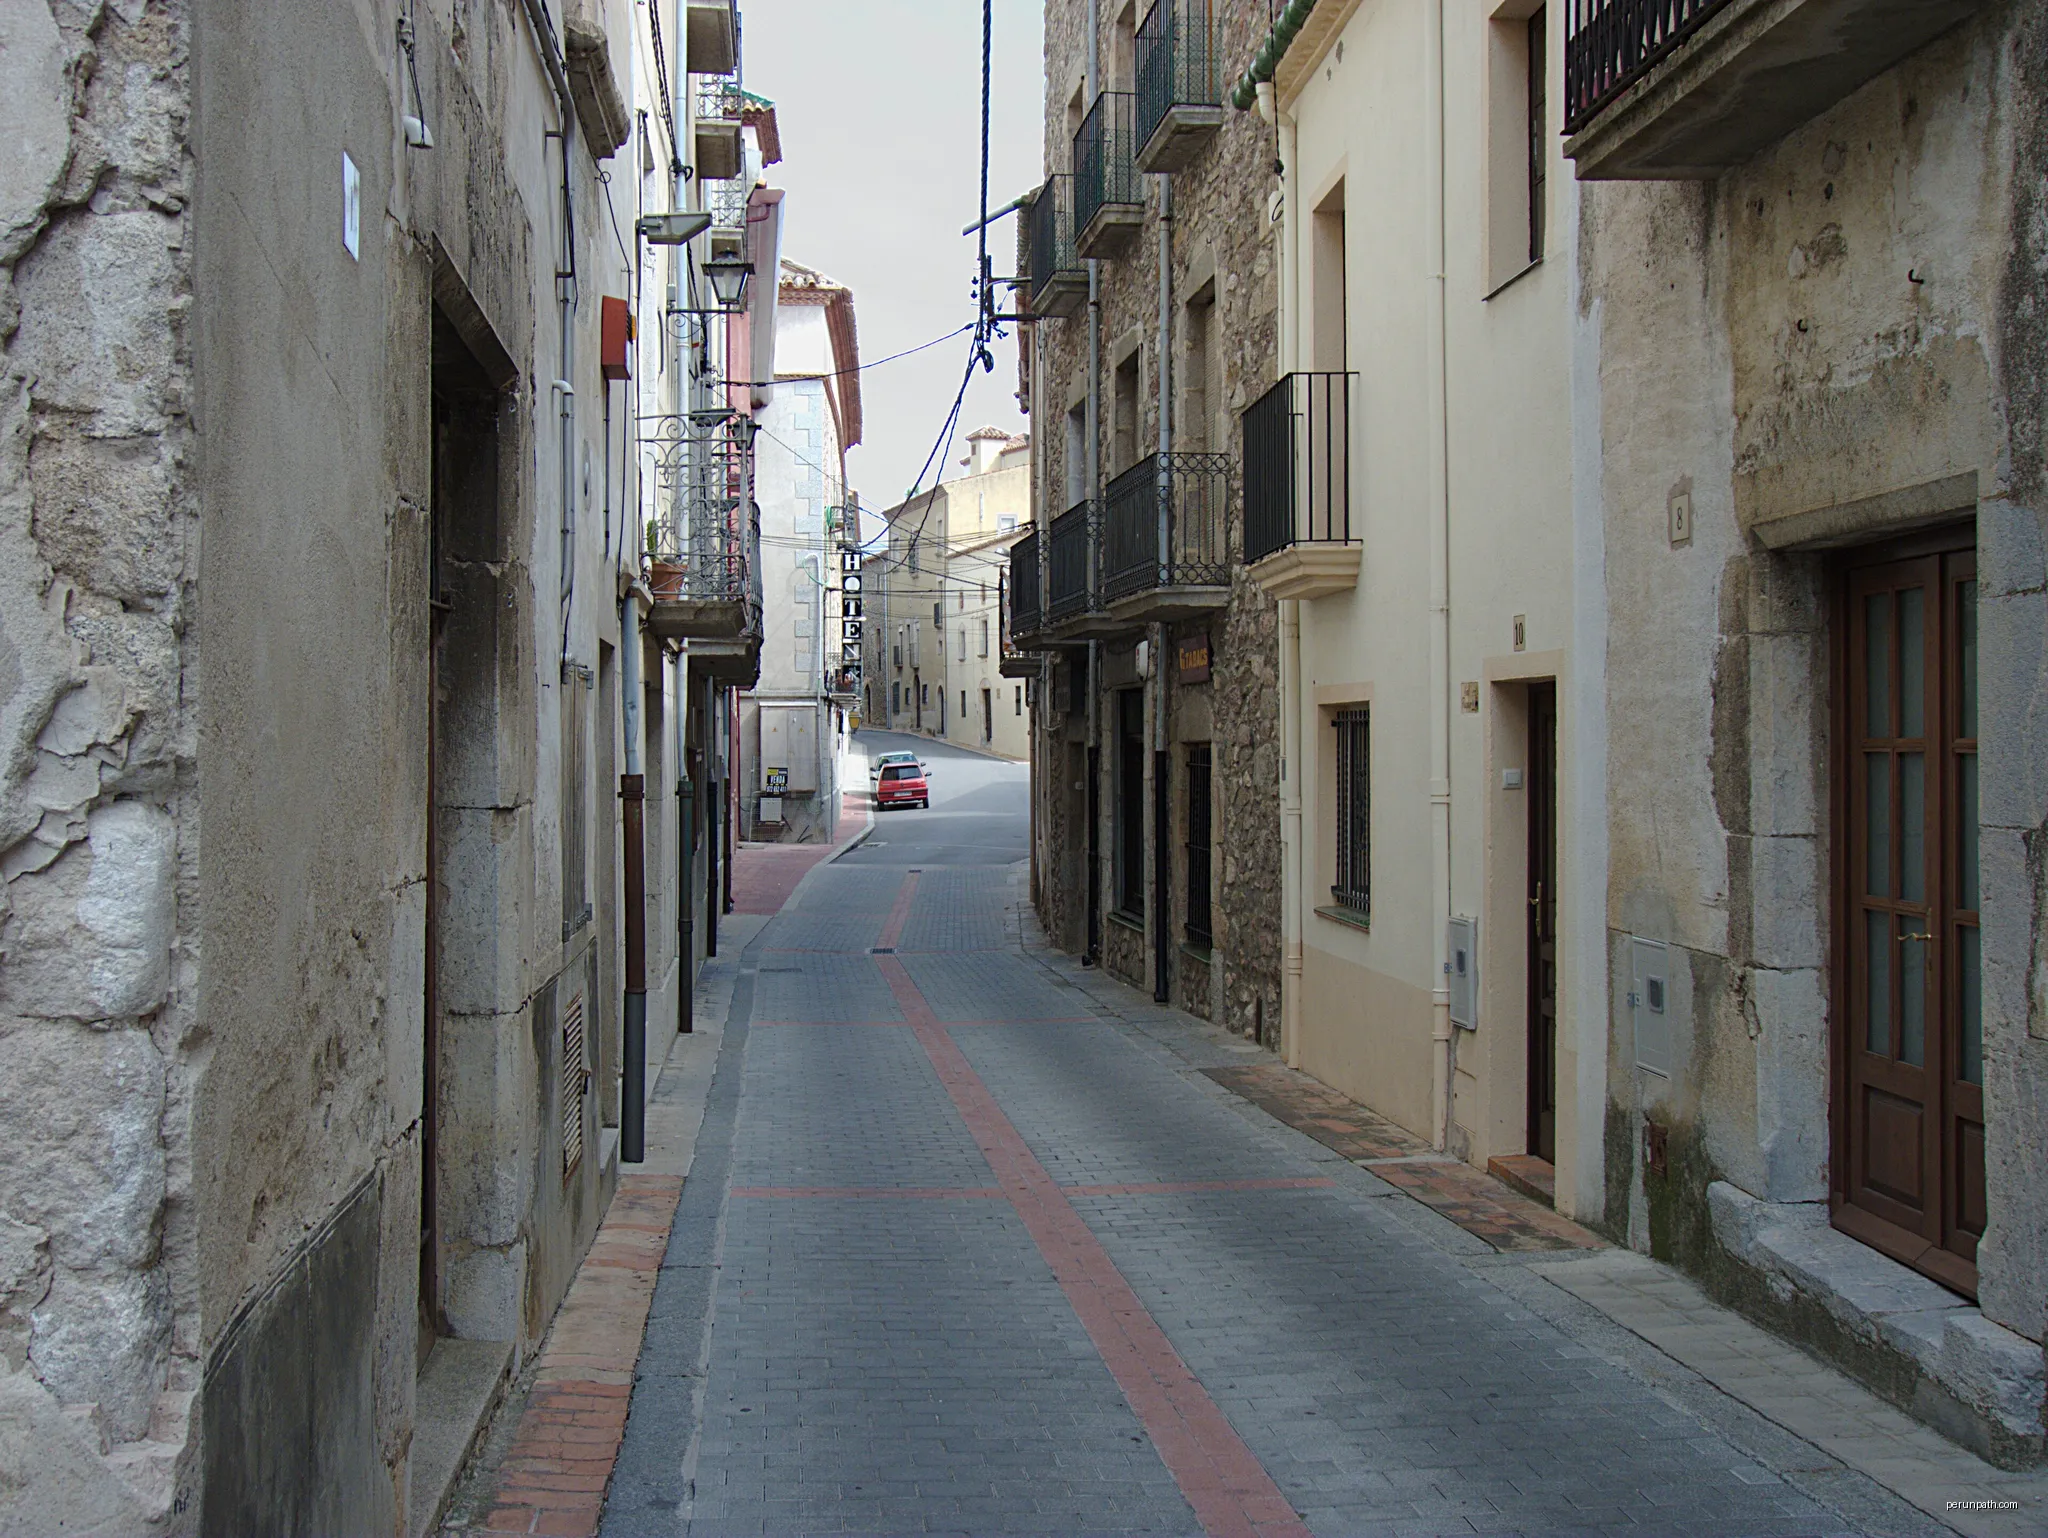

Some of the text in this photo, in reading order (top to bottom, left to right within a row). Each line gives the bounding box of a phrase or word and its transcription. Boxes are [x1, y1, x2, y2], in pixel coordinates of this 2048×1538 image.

[1677, 506, 1683, 530] 8
[1514, 622, 1524, 646] 10
[770, 775, 785, 784] VENDA
